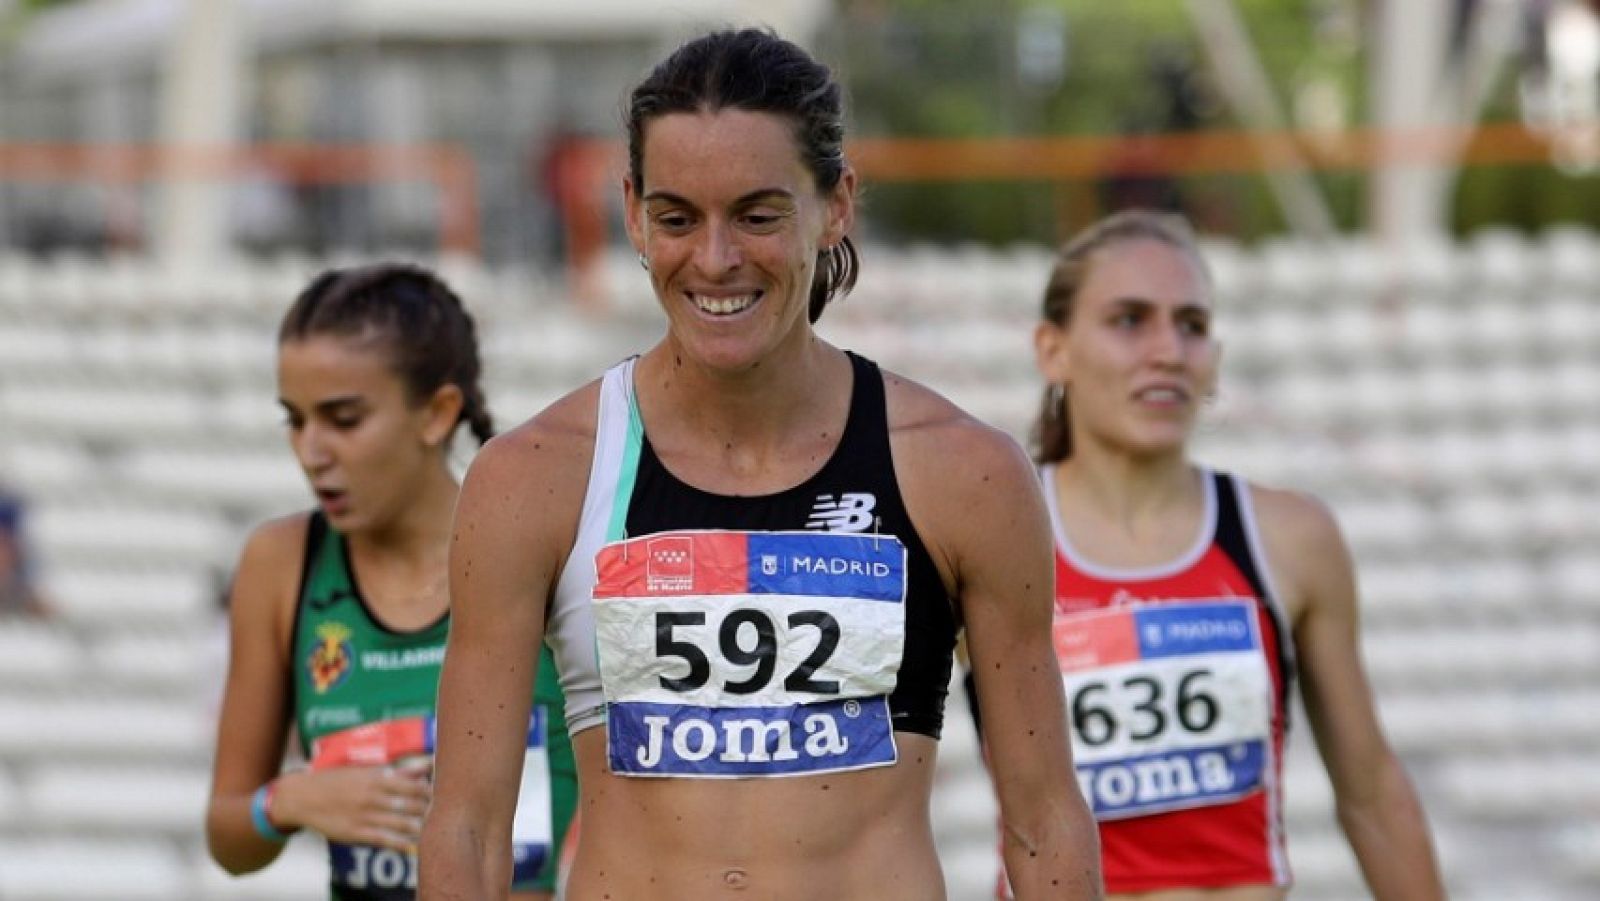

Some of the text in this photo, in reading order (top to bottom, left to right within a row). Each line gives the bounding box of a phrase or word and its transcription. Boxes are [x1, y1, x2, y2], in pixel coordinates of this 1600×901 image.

[792, 556, 890, 577] MADRID
[655, 607, 841, 695] 592
[1072, 668, 1220, 747] 636
